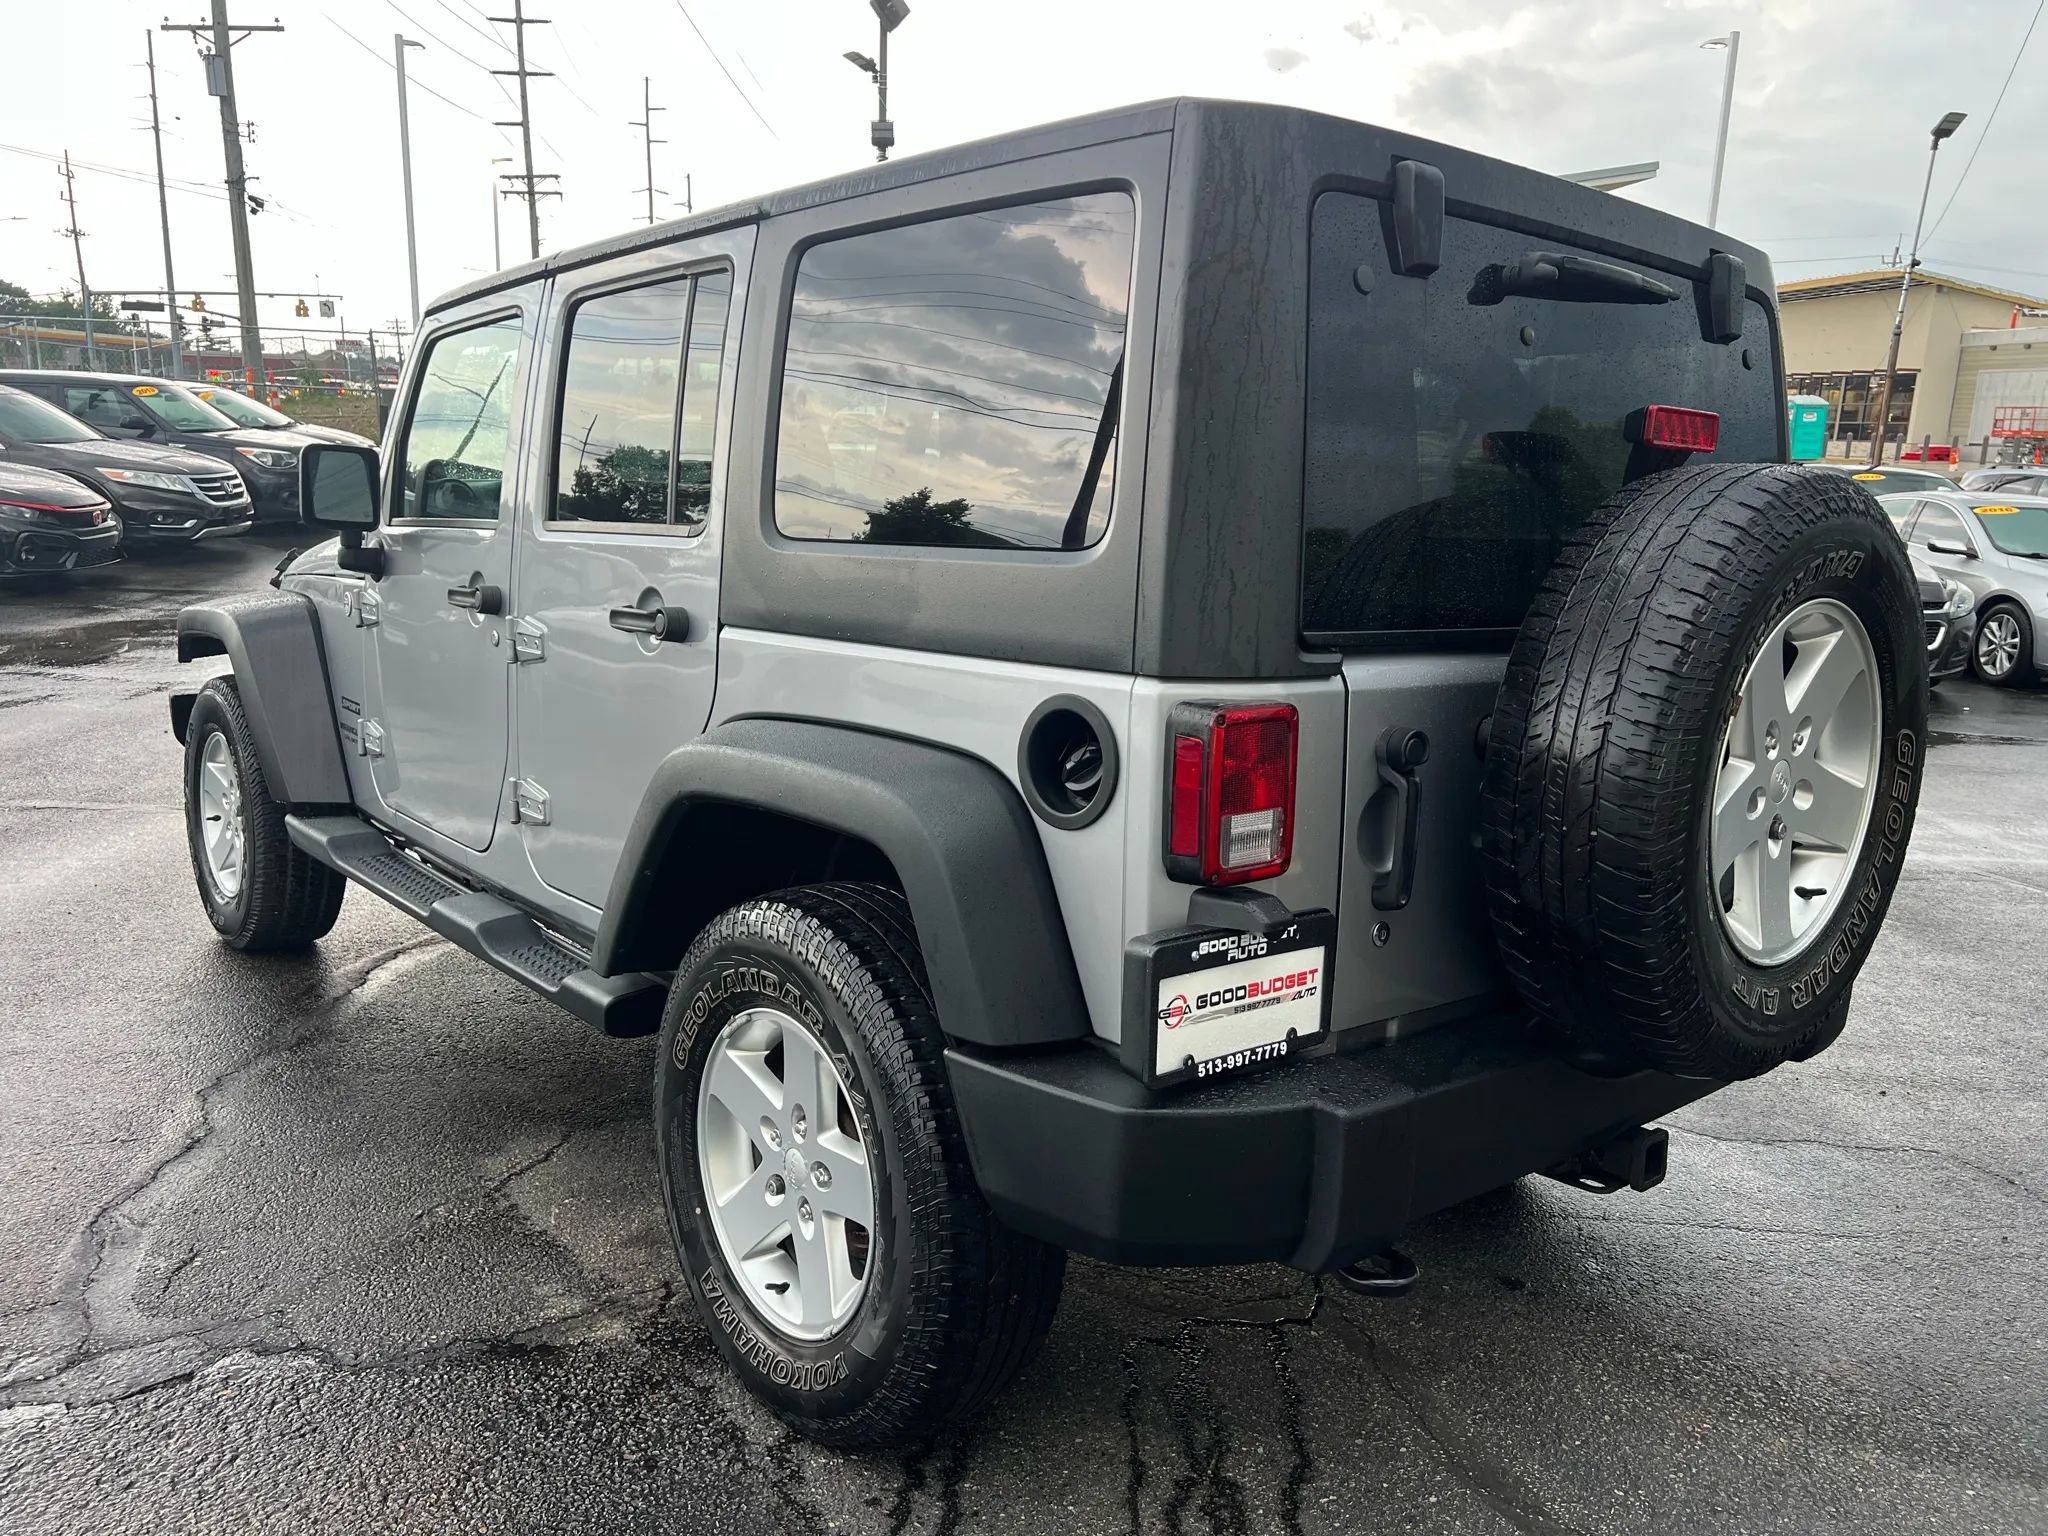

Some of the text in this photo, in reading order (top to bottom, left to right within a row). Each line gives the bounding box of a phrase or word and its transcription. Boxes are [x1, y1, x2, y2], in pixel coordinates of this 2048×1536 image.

[1792, 728, 1917, 1010] GEOLANDAR
[1199, 936, 1239, 955] GOOD
[1227, 942, 1267, 962] AUTO
[1291, 986, 1317, 1002] AUTO
[673, 967, 825, 1071] GEOLANDAR
[1158, 1004, 1192, 1020] GBA
[1197, 1041, 1288, 1078] 513-997-7779
[700, 1266, 849, 1392] YOKOHAMA
